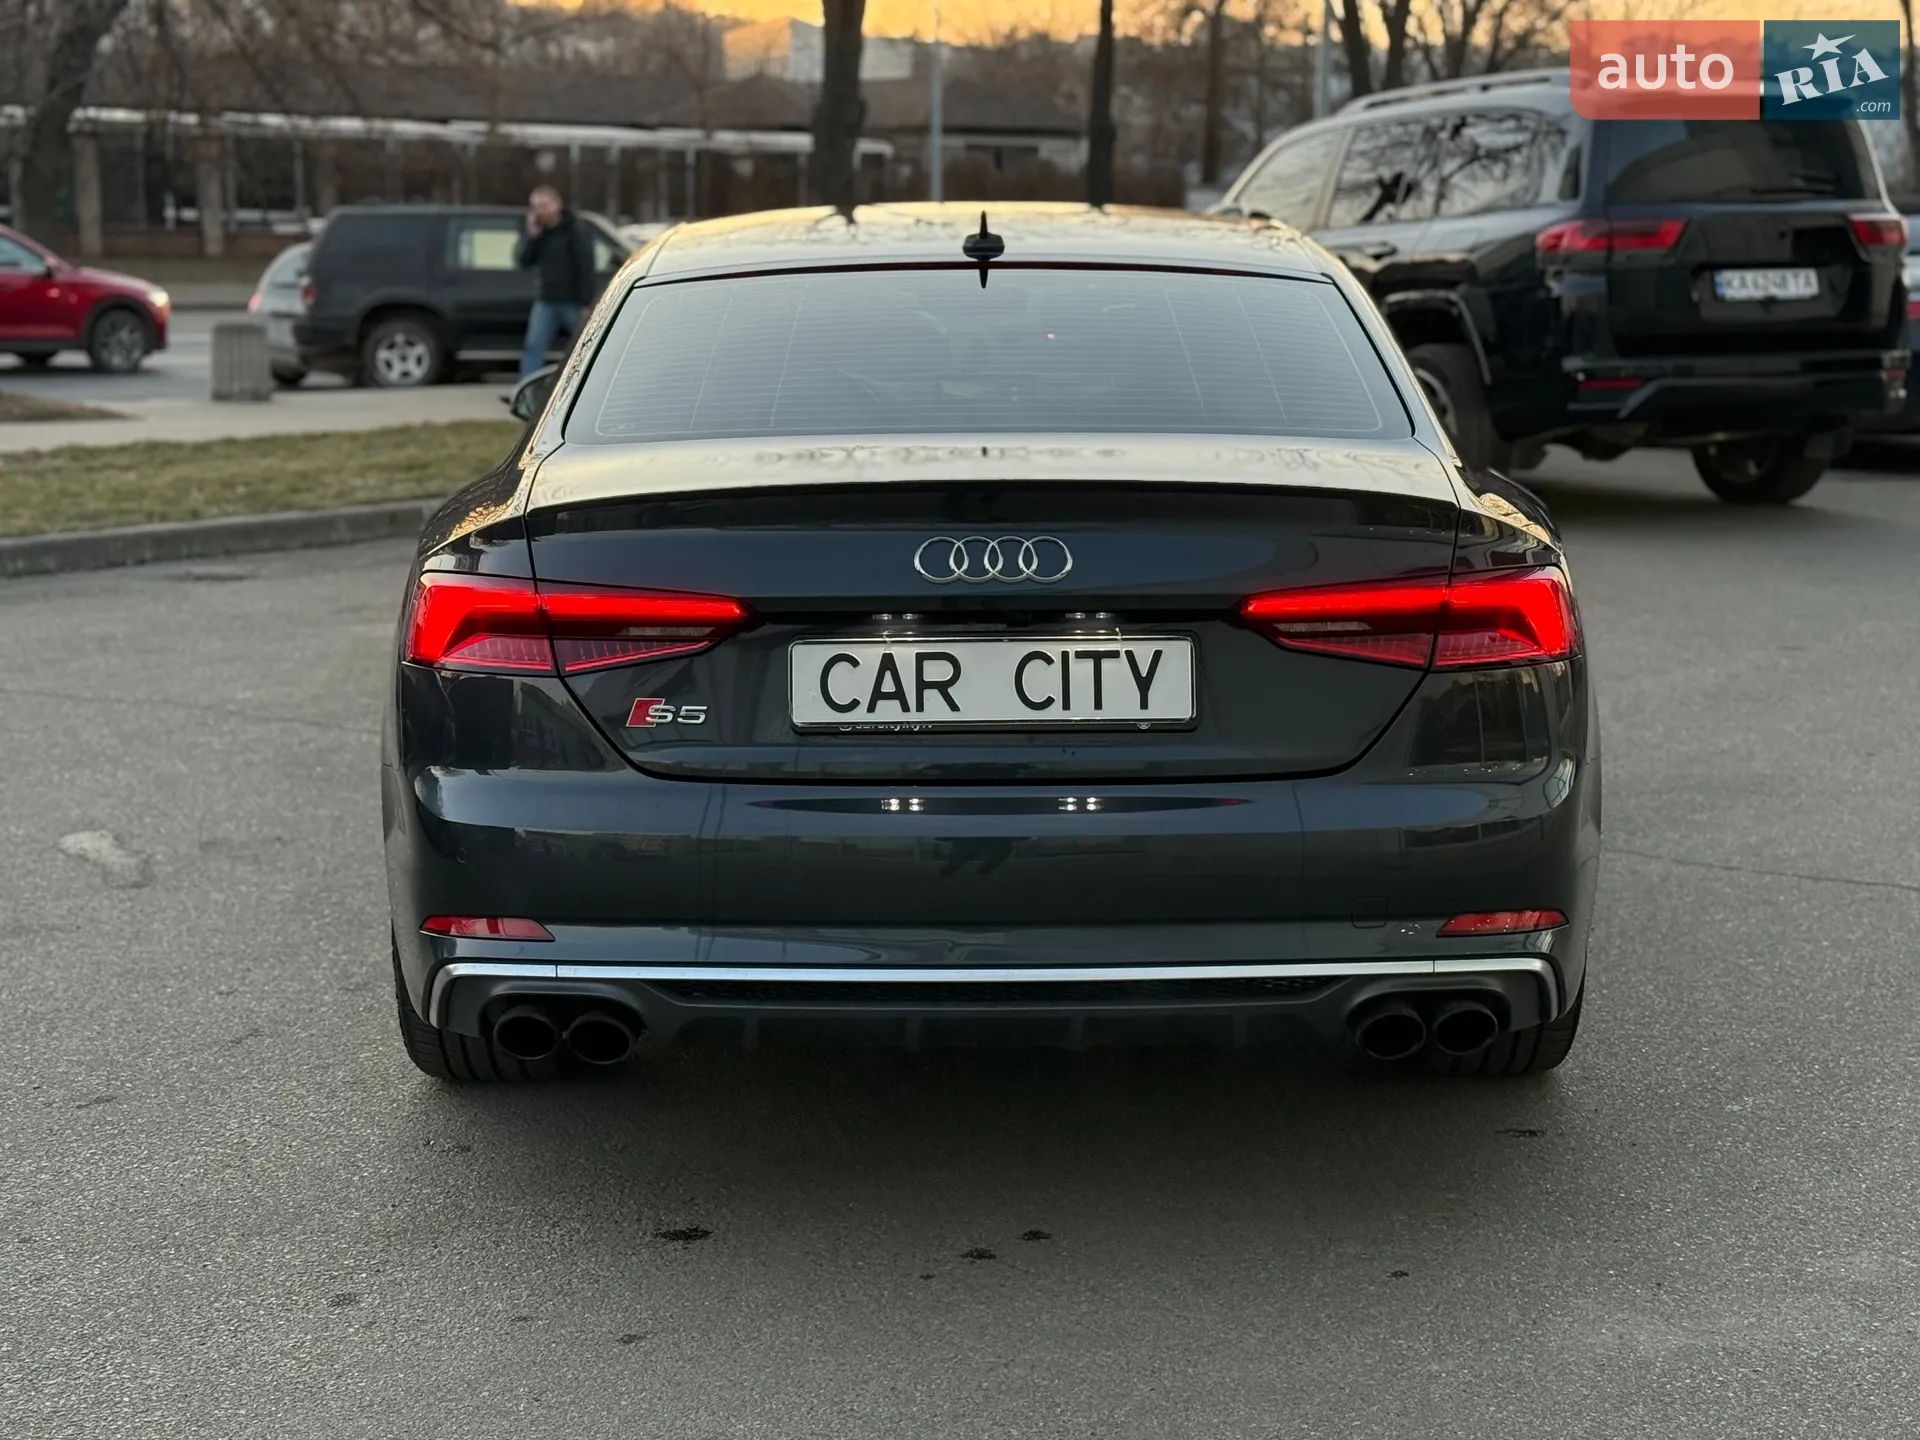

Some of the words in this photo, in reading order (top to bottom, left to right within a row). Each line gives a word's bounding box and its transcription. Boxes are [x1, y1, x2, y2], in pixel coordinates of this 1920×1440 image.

[819, 651, 962, 713] CAR
[1014, 649, 1163, 711] CITY
[645, 705, 708, 724] S5
